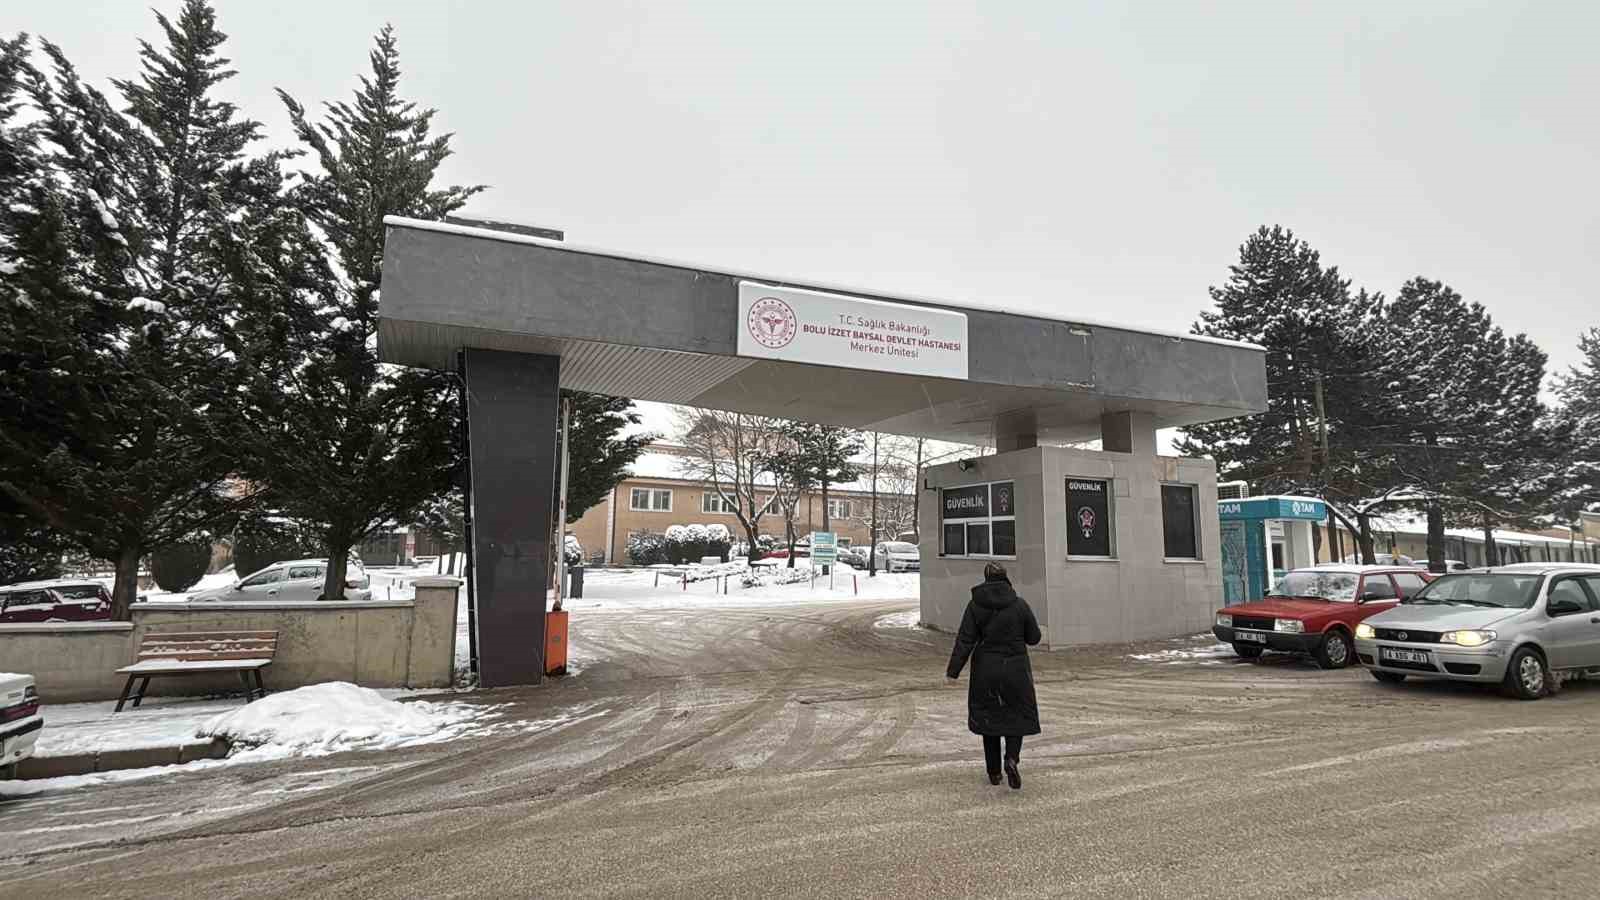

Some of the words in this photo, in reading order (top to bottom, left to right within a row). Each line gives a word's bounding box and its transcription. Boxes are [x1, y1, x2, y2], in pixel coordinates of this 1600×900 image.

[839, 315, 854, 326] T.C.
[858, 316, 886, 331] Sağlık
[889, 321, 930, 337] Bakanlığı
[803, 324, 826, 335] BOLU
[828, 325, 851, 339] İZZET
[852, 331, 885, 343] BAYSAL
[886, 335, 916, 347] DEVLET
[918, 338, 961, 351] HASTANESİ
[850, 341, 885, 354] Merkez
[887, 345, 919, 358] Ünitesi
[1069, 481, 1102, 491] GÜVENLİK
[946, 494, 984, 510] GÜVENLİK
[1219, 503, 1241, 514] TAM
[1301, 503, 1315, 513] TAM
